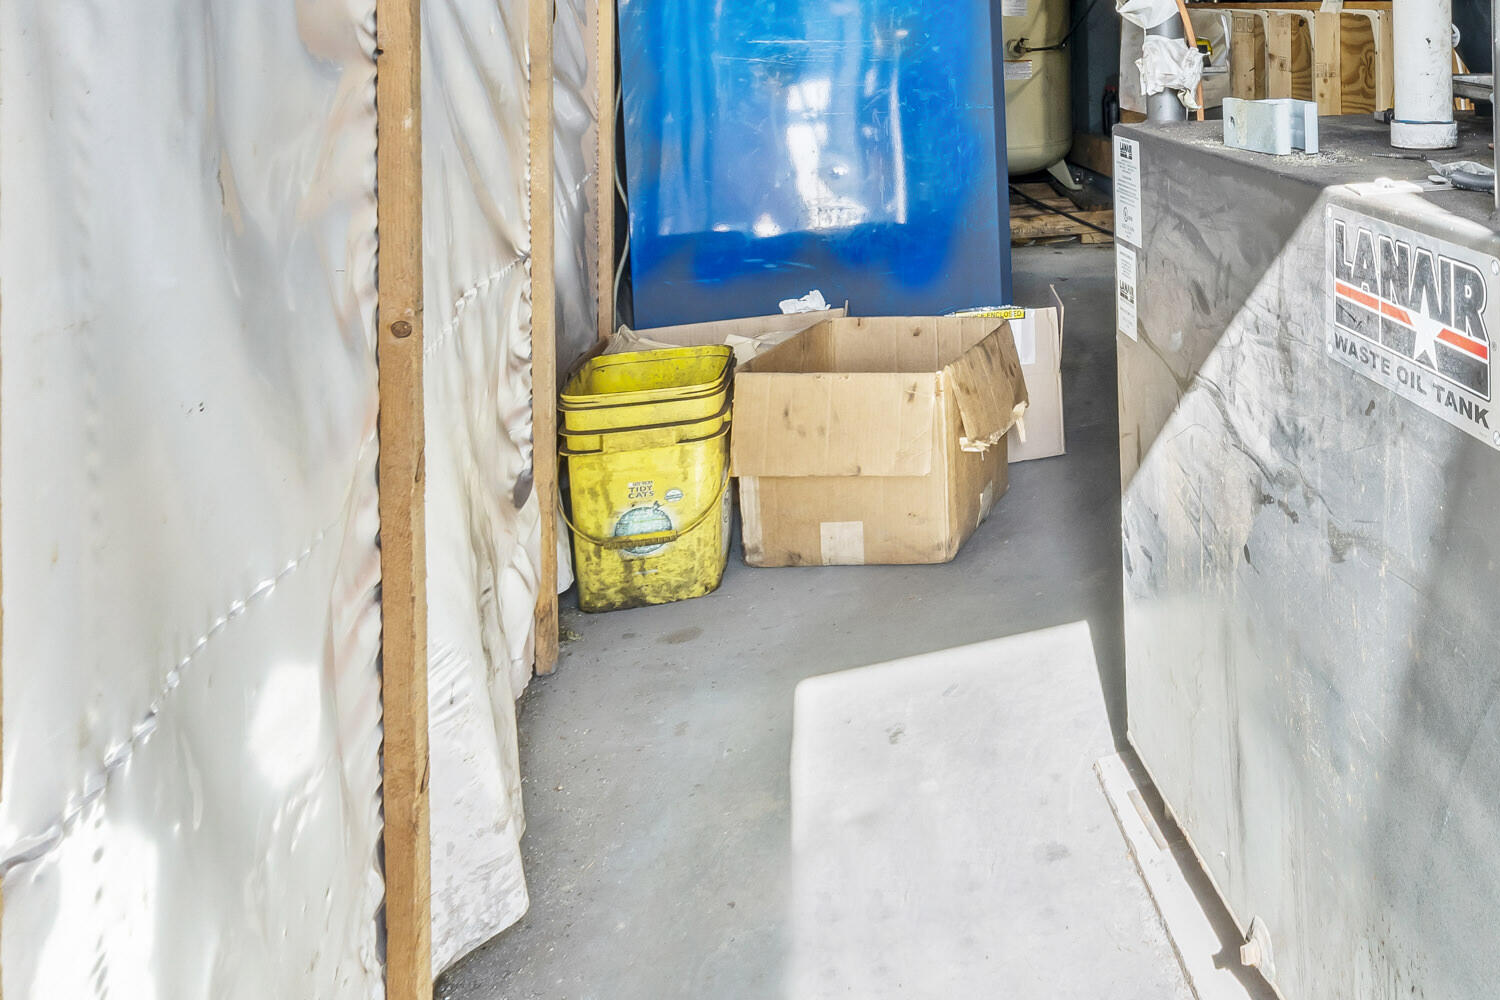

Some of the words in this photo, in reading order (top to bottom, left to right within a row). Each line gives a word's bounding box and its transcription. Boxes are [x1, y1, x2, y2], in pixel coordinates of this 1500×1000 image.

[1334, 220, 1490, 344] LANAIR
[1334, 333, 1391, 376] WASTE
[1397, 368, 1428, 396] OIL
[1433, 383, 1490, 430] TANK
[628, 485, 653, 493] TIDY
[628, 491, 655, 499] CATS
